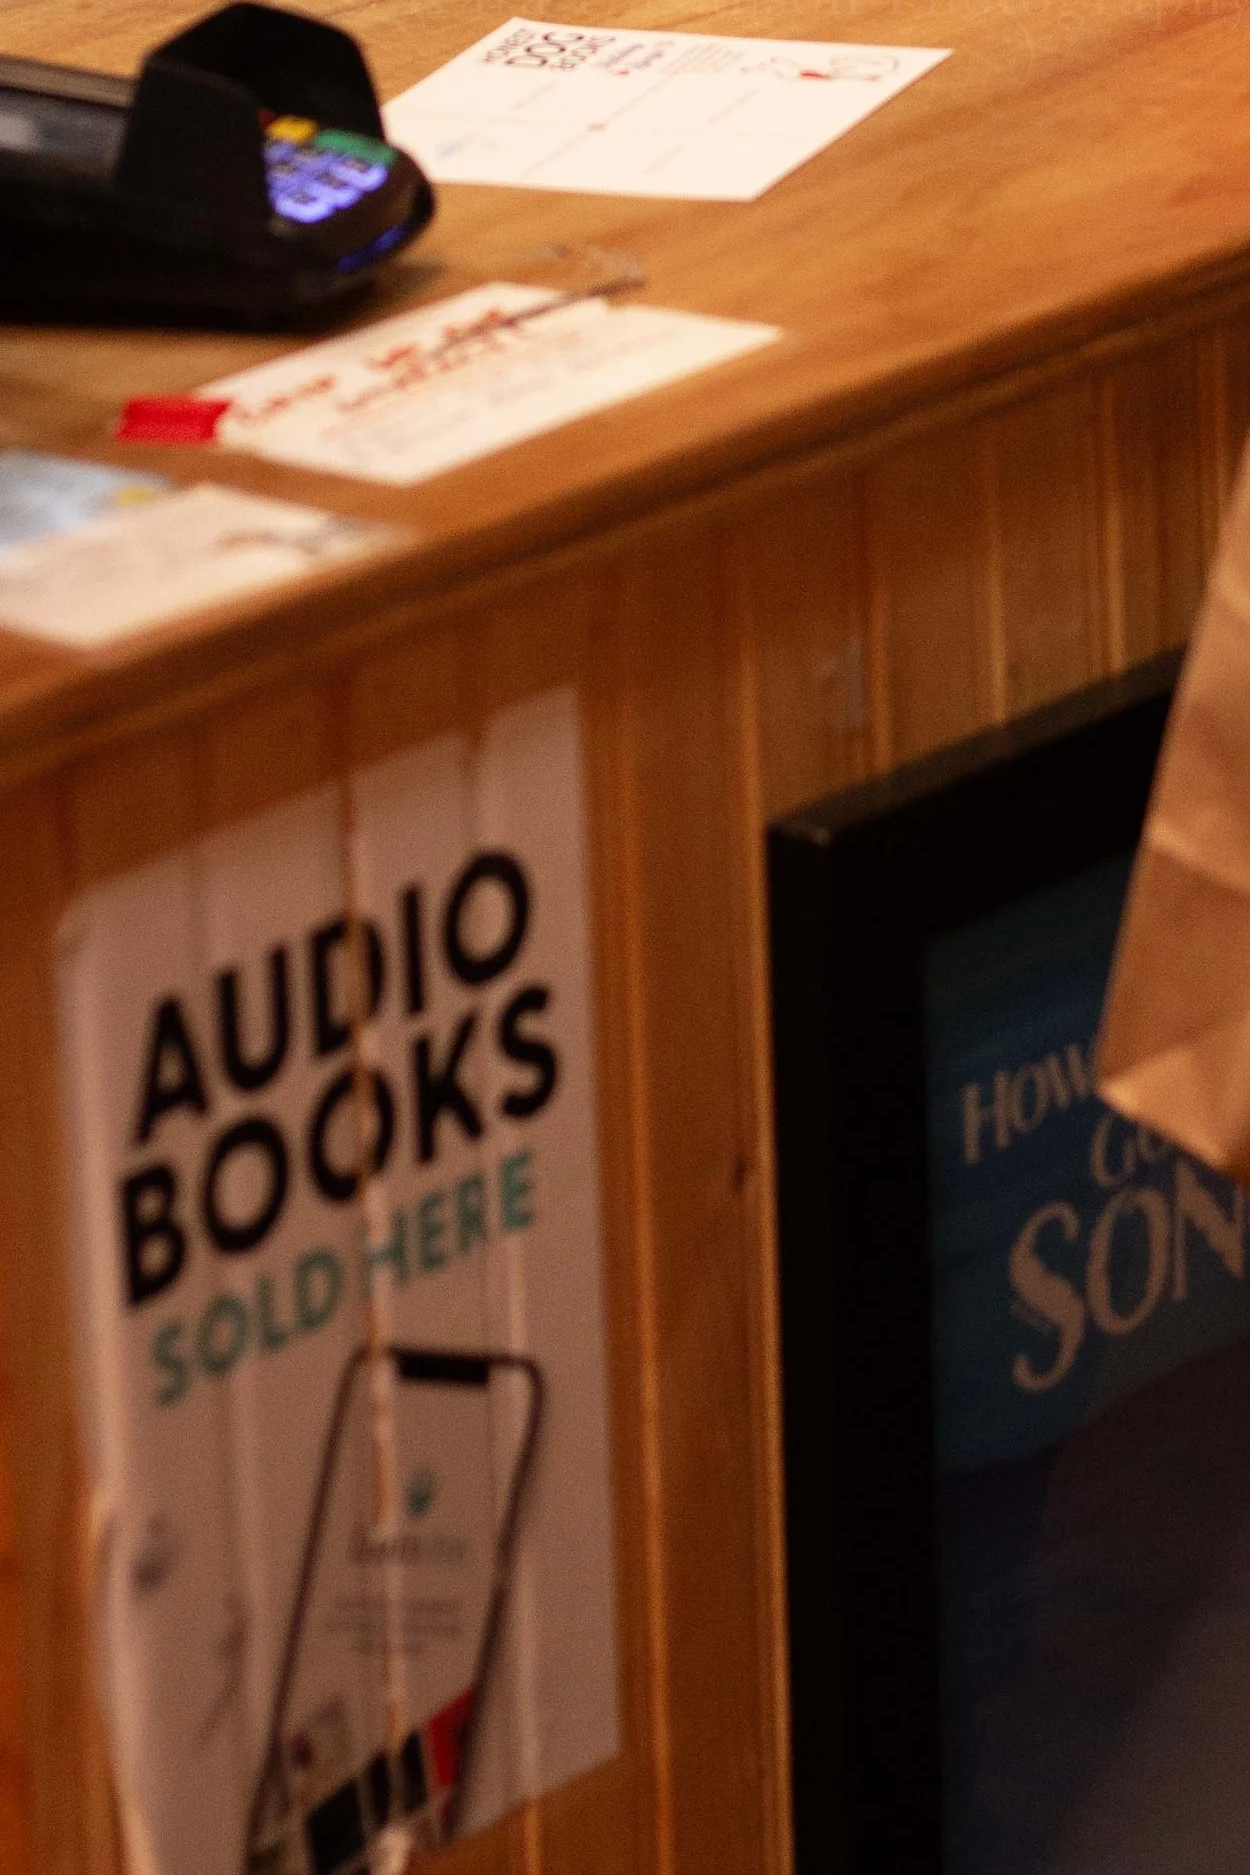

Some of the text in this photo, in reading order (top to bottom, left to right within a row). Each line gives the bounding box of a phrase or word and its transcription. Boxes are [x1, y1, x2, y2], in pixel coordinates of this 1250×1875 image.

[121, 983, 559, 1308] BOOKS
[135, 847, 533, 1146] AUDIO
[150, 1148, 537, 1409] SOLD HERE
